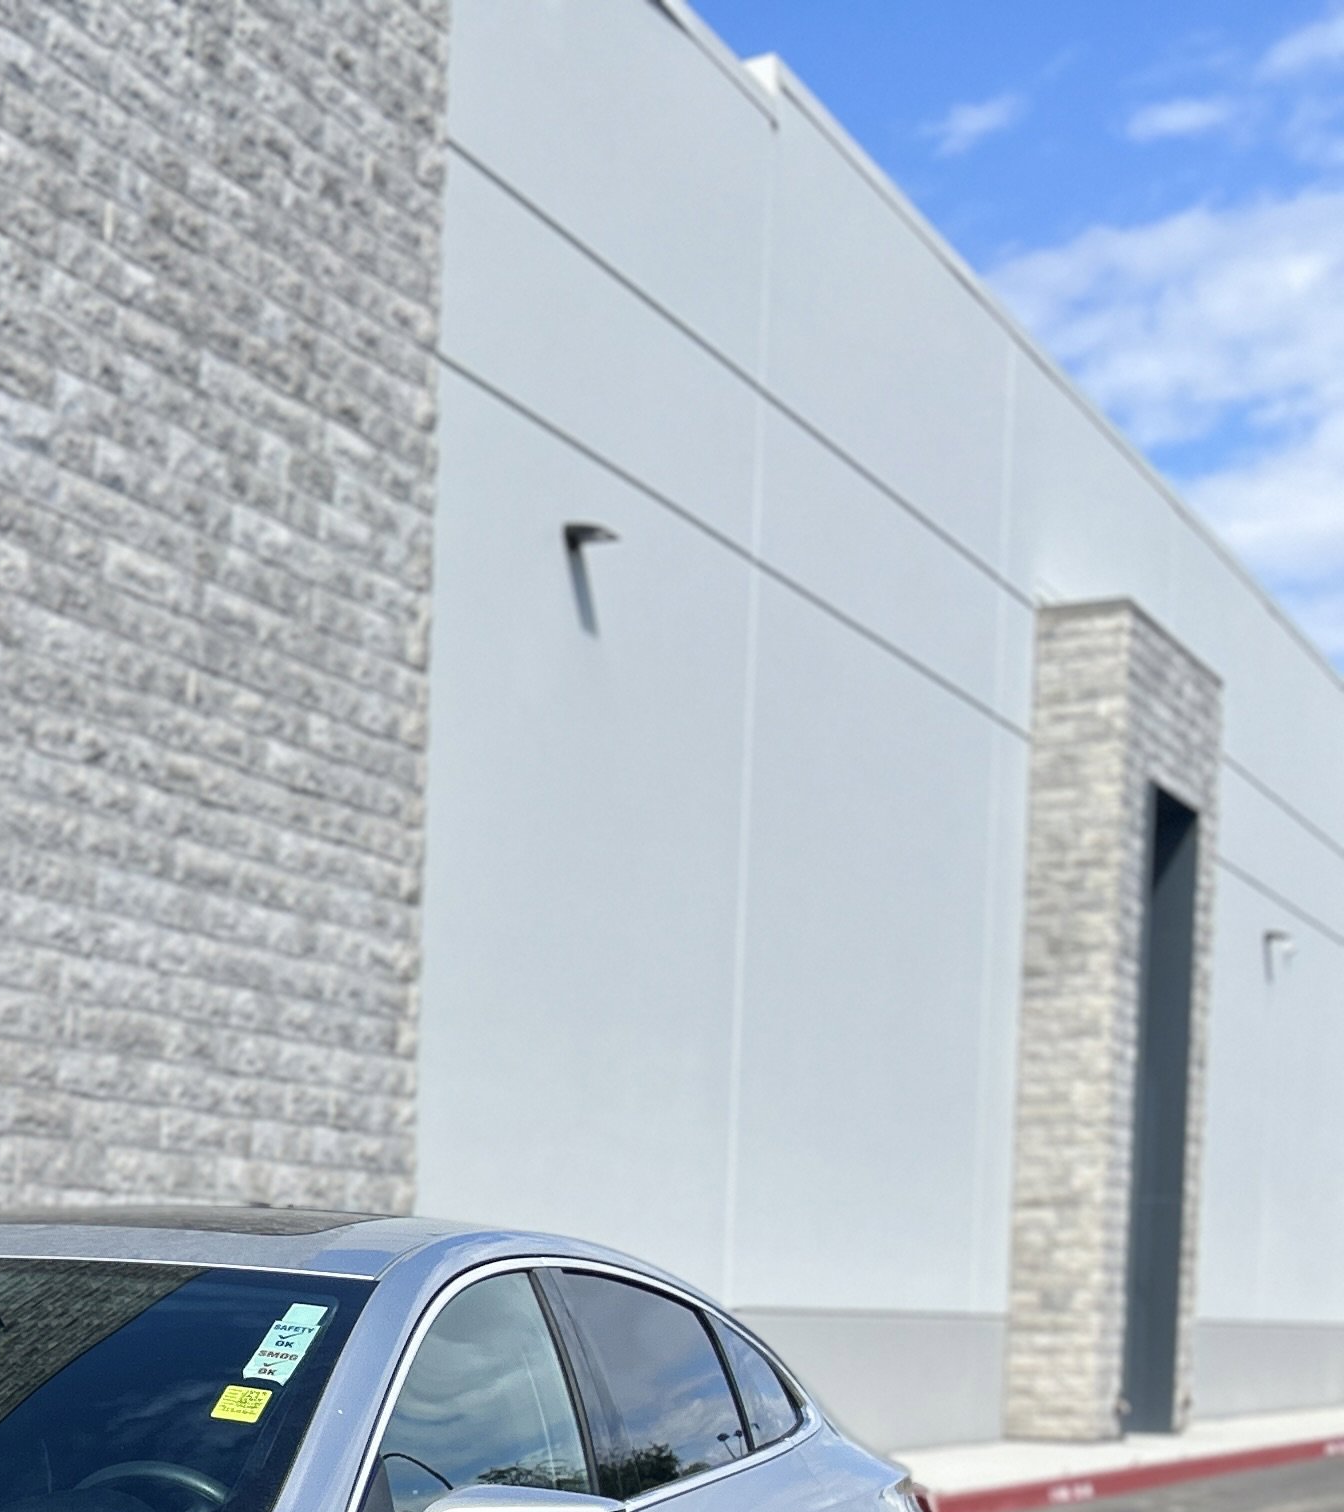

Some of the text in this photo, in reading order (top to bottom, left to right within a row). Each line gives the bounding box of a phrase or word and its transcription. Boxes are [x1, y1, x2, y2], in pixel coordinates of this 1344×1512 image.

[274, 1324, 315, 1334] SAFETY
[275, 1340, 294, 1348] OK
[258, 1350, 299, 1361] SMOG
[258, 1368, 277, 1376] OK
